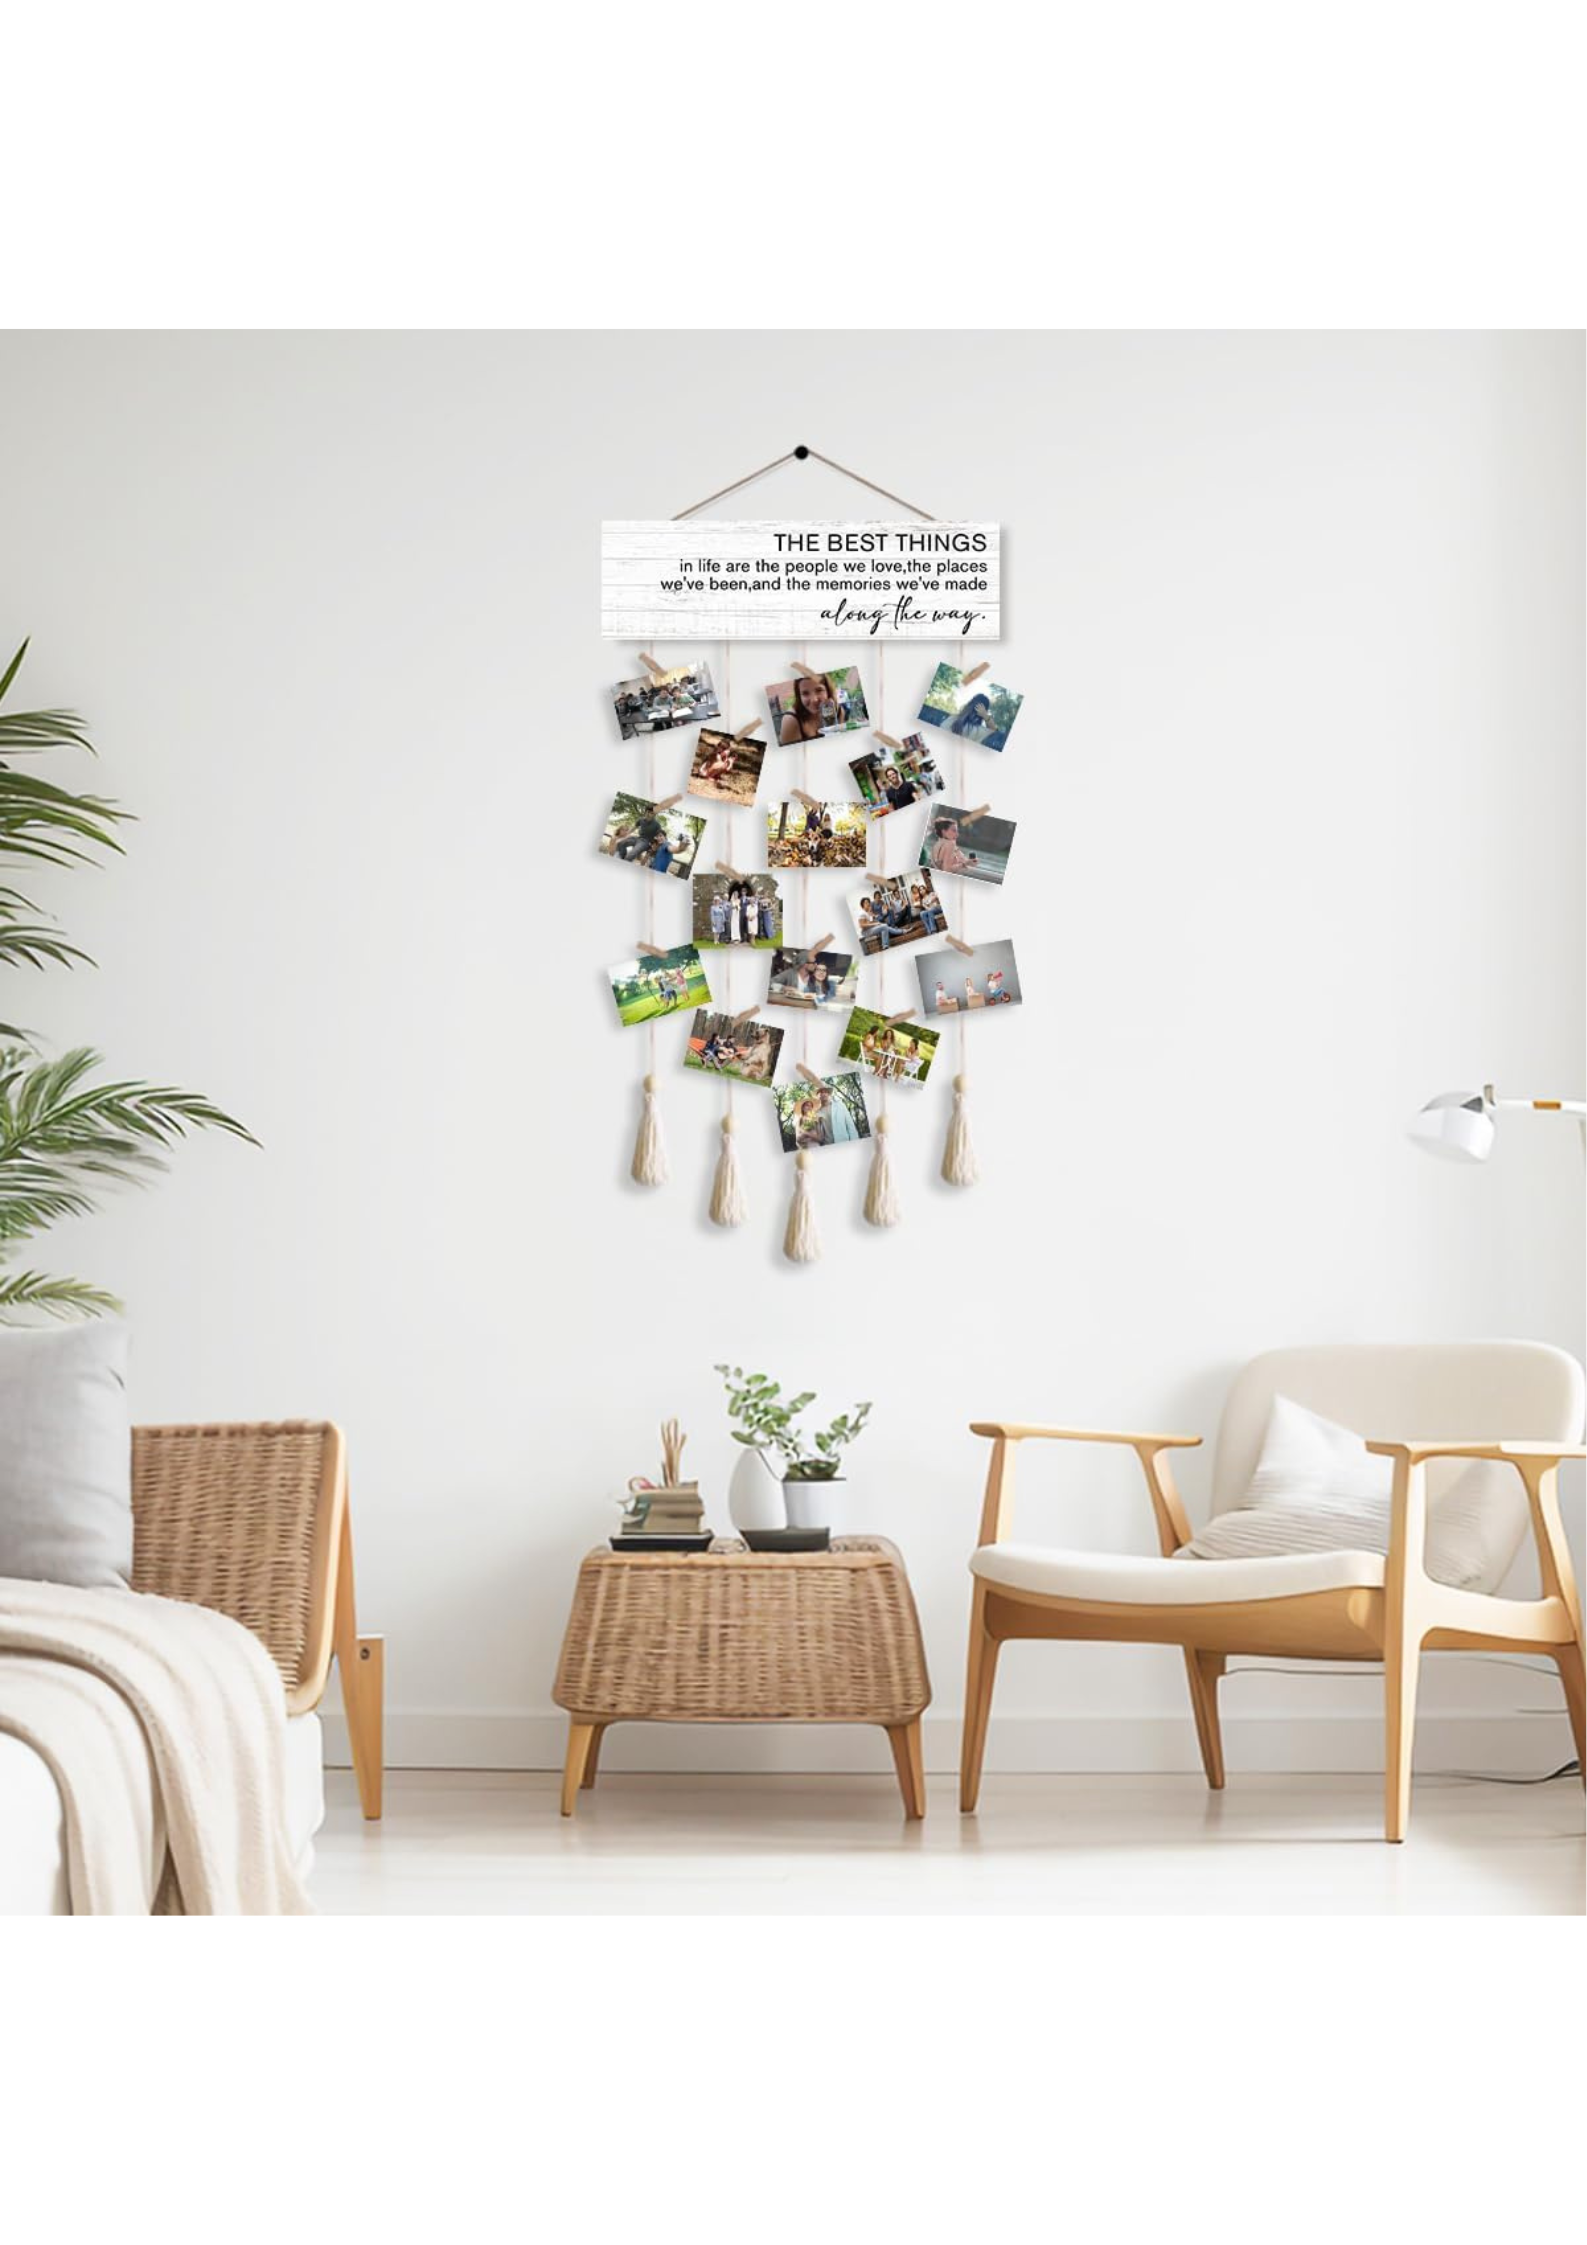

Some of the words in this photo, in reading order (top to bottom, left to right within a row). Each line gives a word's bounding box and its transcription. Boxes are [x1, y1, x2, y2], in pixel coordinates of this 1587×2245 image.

[774, 533, 819, 552] THE
[828, 533, 888, 552] BEST
[895, 533, 987, 552] THINGS
[679, 558, 693, 573] in
[698, 558, 721, 573] life
[725, 562, 750, 573] are
[755, 558, 780, 573] the
[785, 558, 838, 576] people
[843, 562, 866, 573] we
[936, 558, 988, 576] places
[660, 576, 704, 591] we've
[786, 576, 810, 591] the
[816, 576, 891, 591] memories
[895, 576, 940, 591] we've
[945, 576, 988, 591] made
[820, 597, 888, 635] along
[886, 594, 927, 631] the
[931, 610, 986, 635] way.
